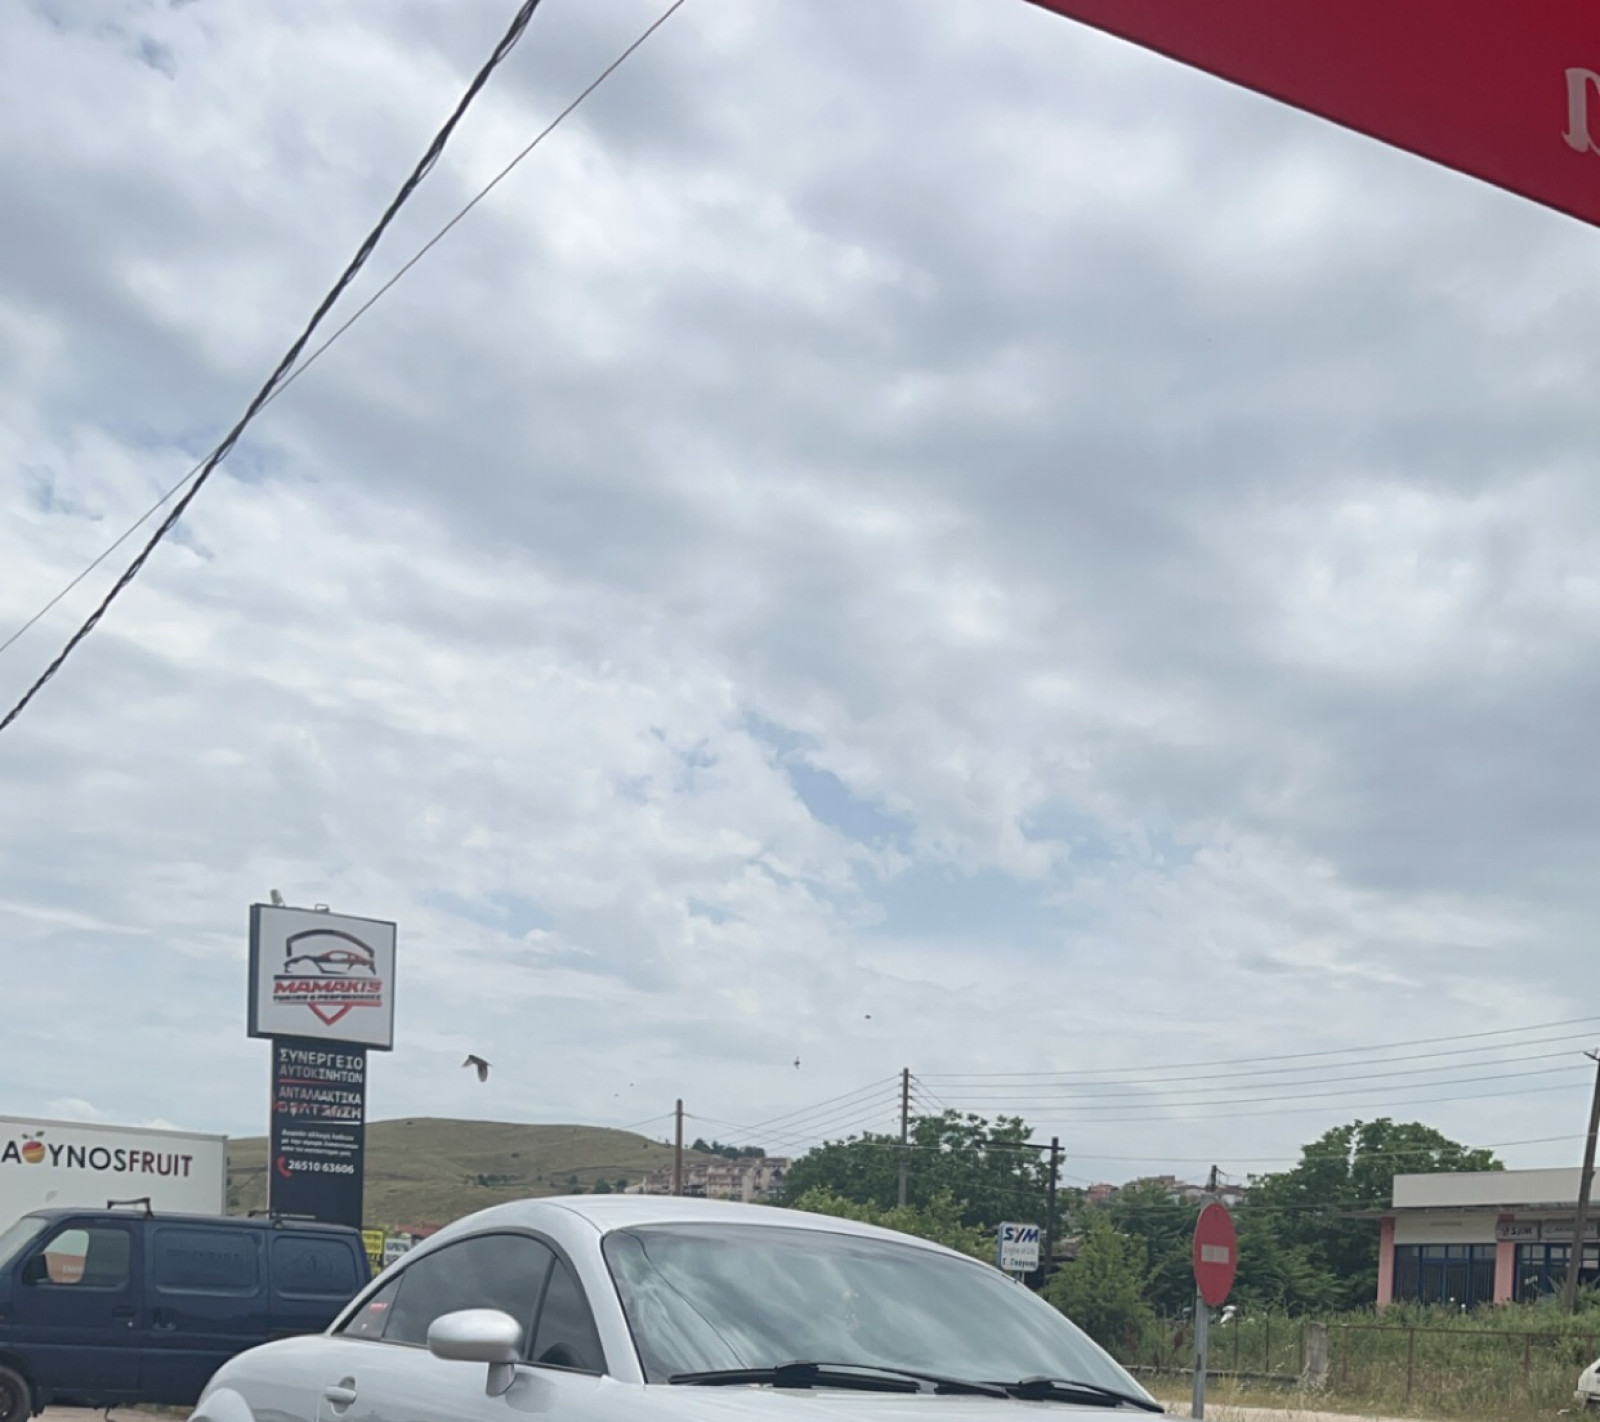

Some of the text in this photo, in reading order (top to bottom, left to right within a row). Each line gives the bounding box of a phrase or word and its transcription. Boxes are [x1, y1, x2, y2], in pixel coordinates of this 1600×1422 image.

[273, 980, 382, 993] MAMAKIS
[279, 1048, 363, 1070] ΣΥΝΕΡΓΕΙΟ
[279, 1064, 363, 1083] ΑΥΤΟΚΙΝΗΤΩΝ
[279, 1086, 362, 1104] ΑΝΤΑΛΛΑΚΤΙΚΑ
[288, 1160, 320, 1172] 26510
[1004, 1226, 1039, 1243] SYM
